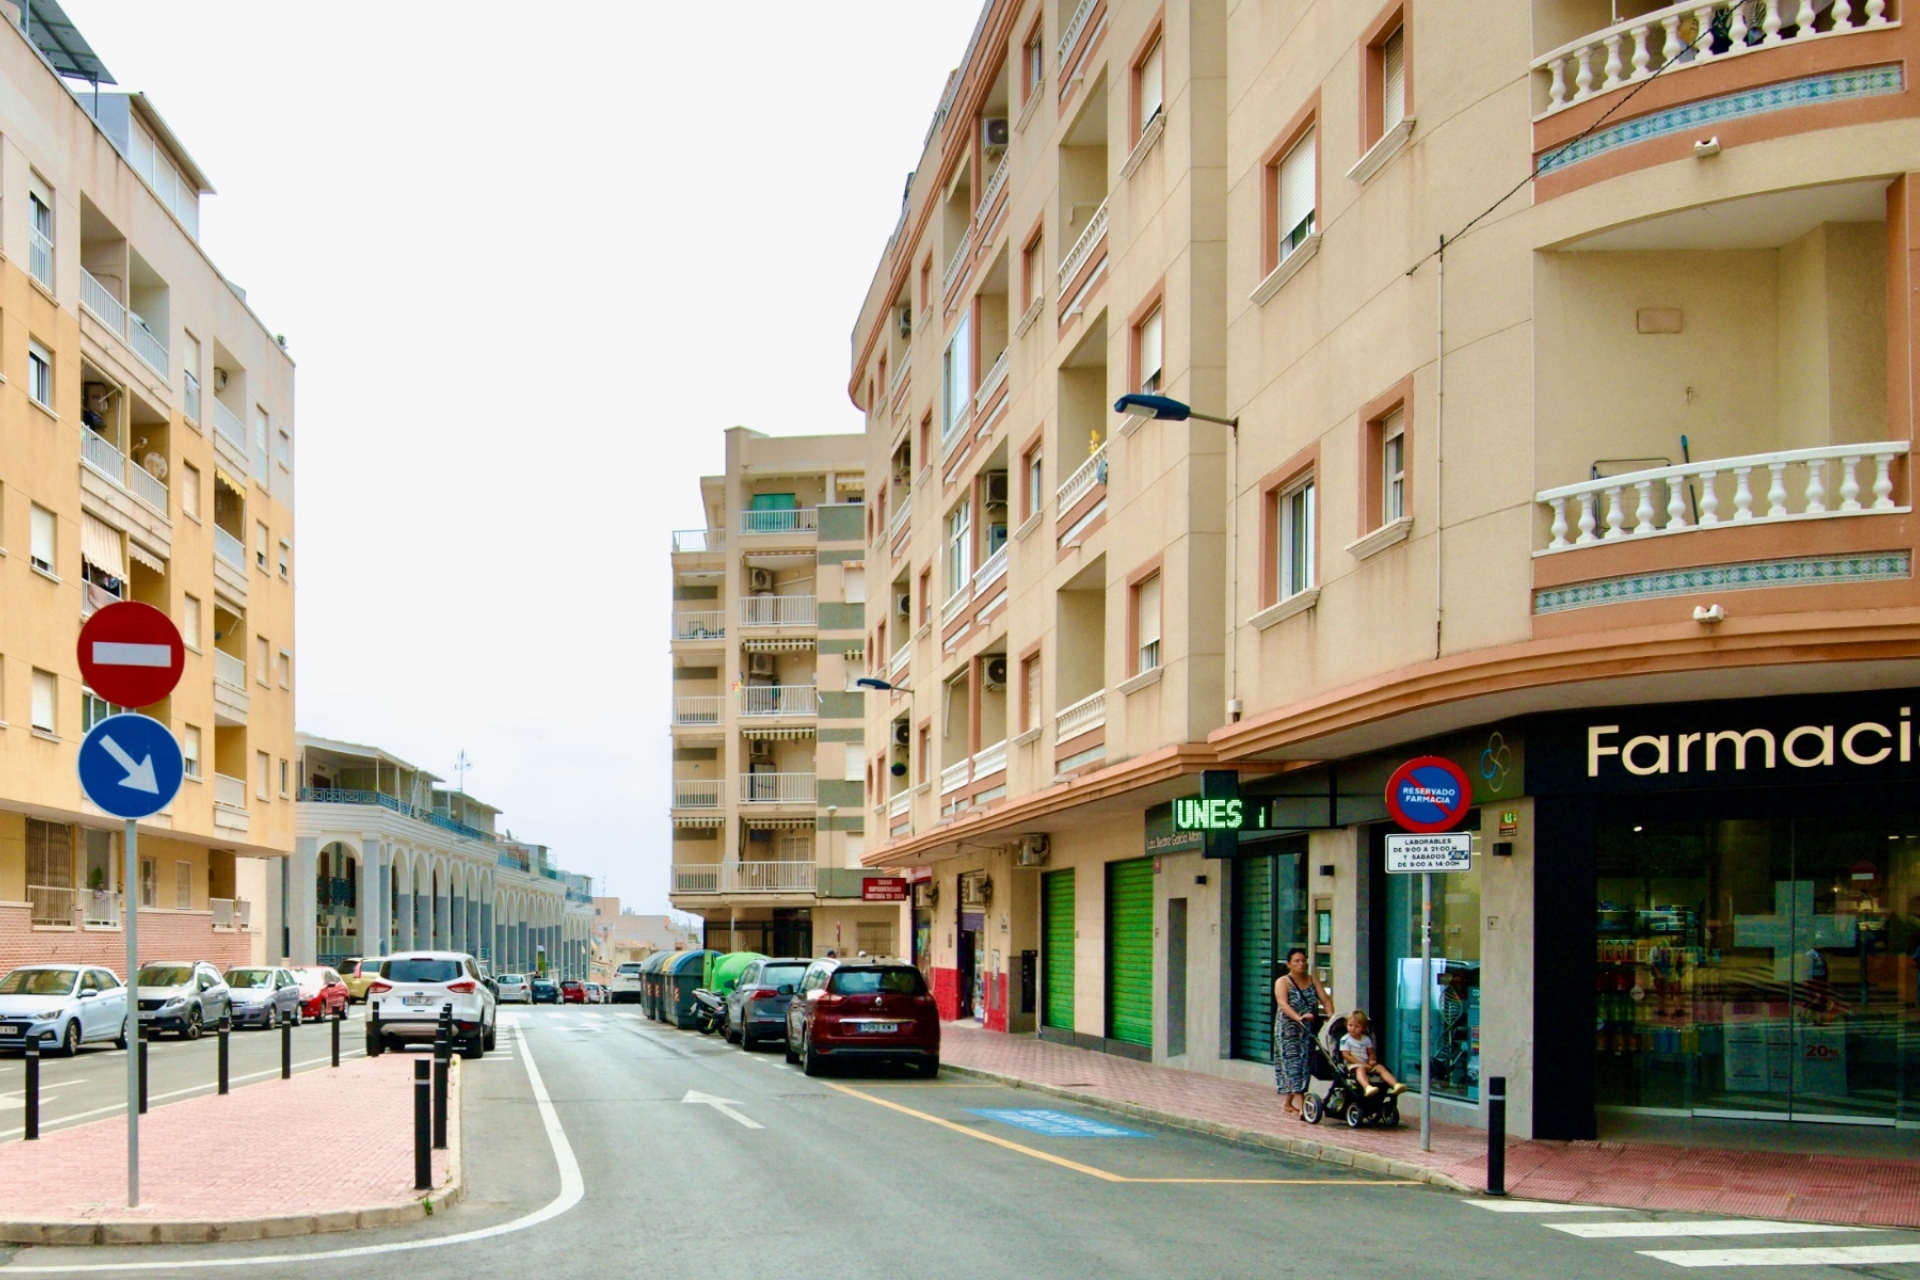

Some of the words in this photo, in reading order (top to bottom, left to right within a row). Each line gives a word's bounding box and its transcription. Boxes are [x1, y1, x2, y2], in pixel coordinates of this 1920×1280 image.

[1588, 706, 1920, 777] Farmaci
[1402, 787, 1455, 796] RESERVADO
[1405, 795, 1450, 803] FARMACIA
[1178, 800, 1242, 828] UNES
